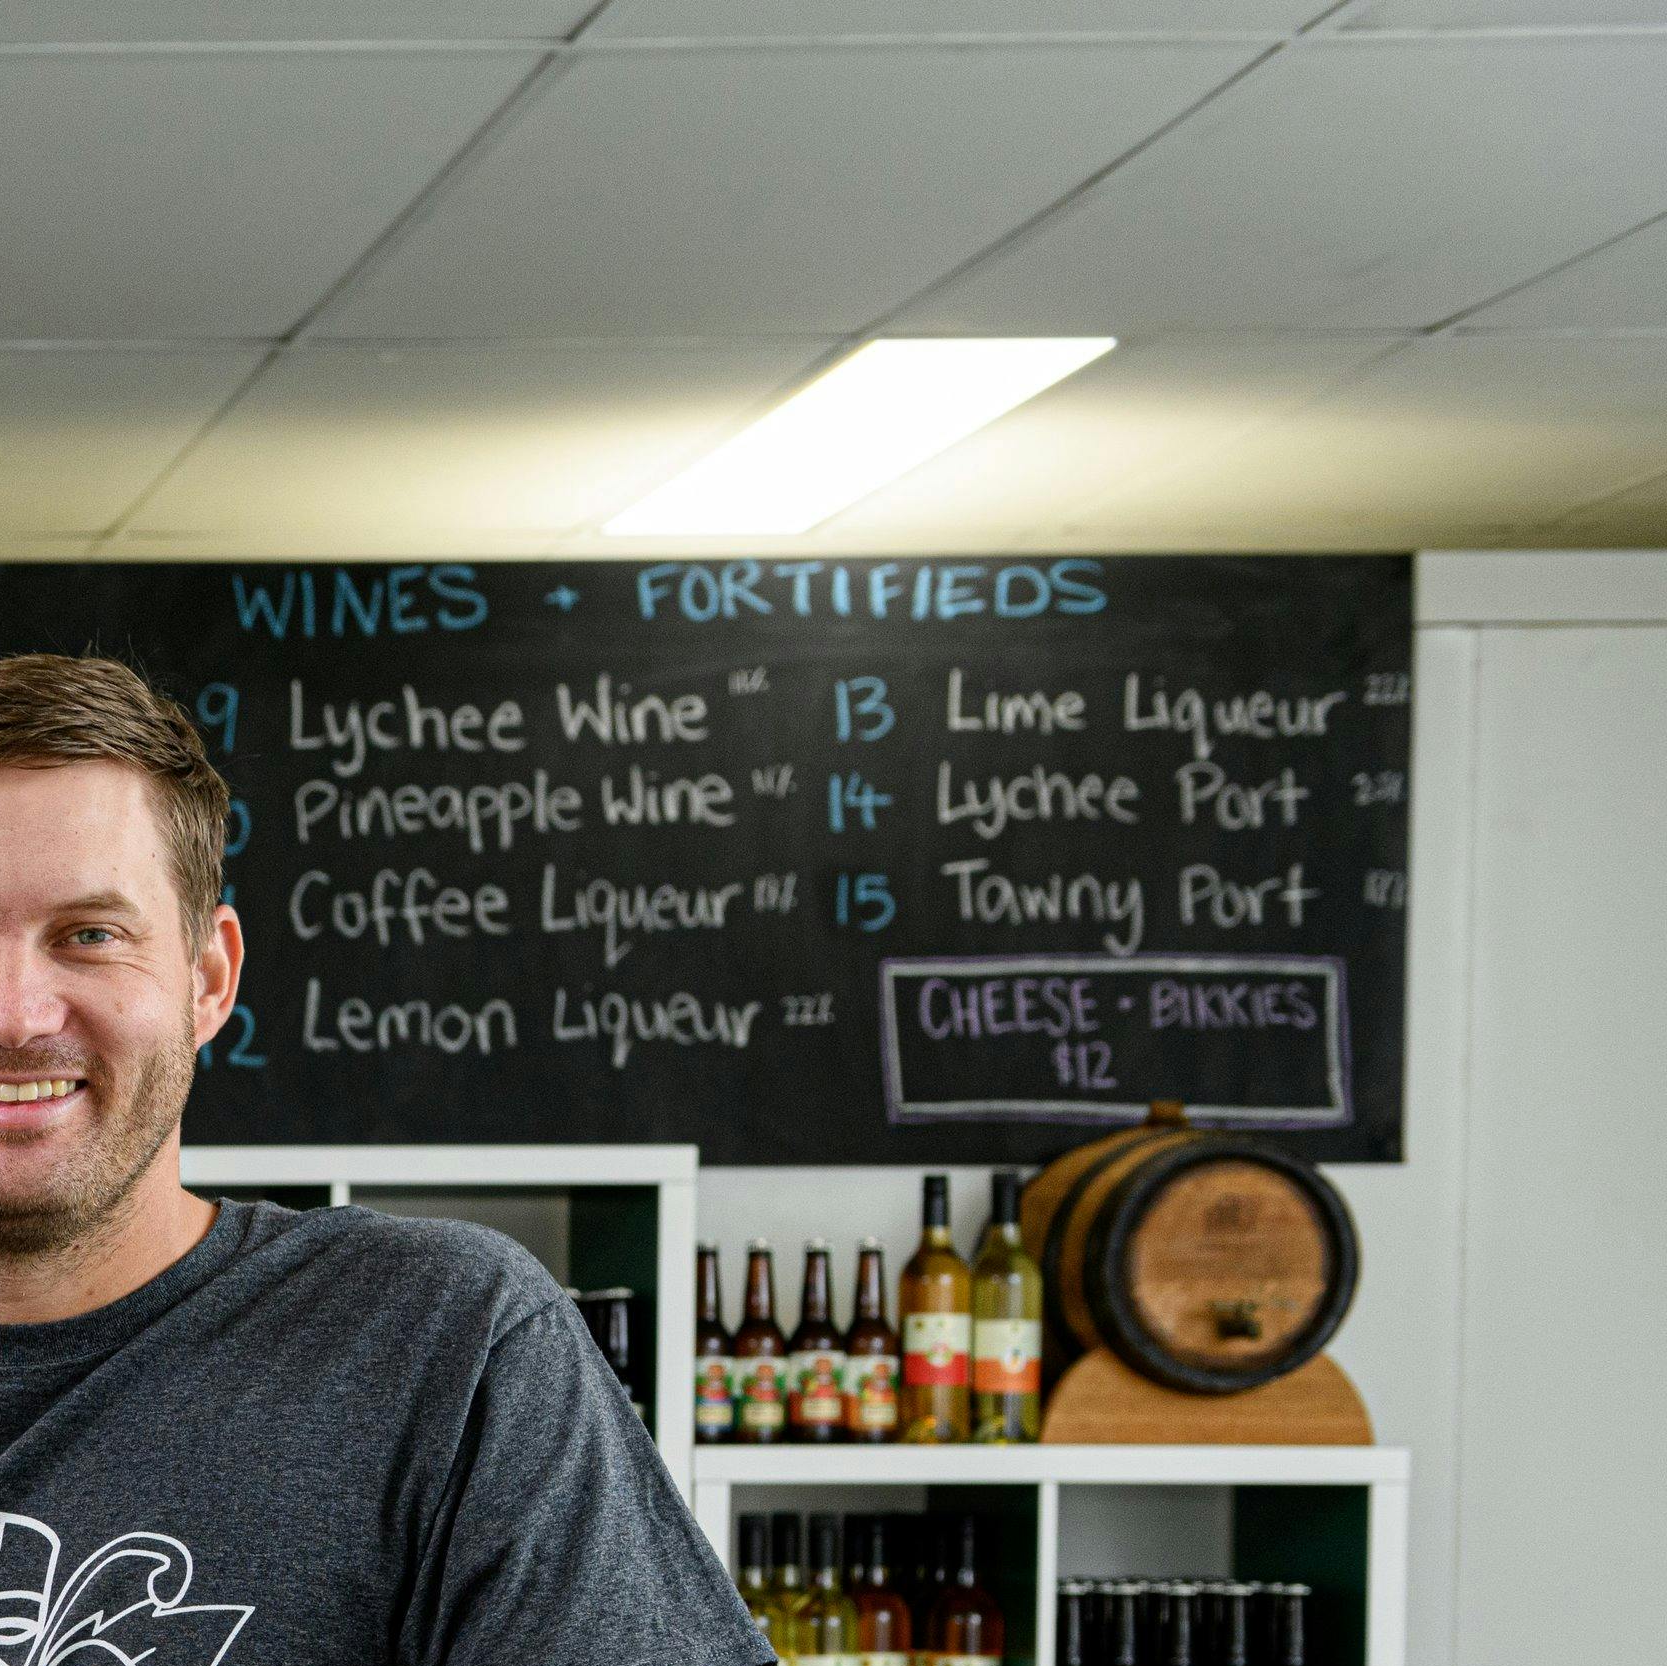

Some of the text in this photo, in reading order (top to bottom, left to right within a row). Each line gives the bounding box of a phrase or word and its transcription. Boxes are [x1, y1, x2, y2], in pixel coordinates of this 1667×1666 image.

[233, 565, 487, 640] WINES
[637, 558, 1109, 622] FORTIFIEDS
[197, 683, 239, 753] 9
[288, 679, 525, 776] Lychee
[556, 671, 708, 743] Wine
[836, 676, 896, 742] 13
[947, 668, 1087, 734] Lime
[1125, 672, 1346, 761] Liqueur
[294, 770, 583, 854] Pineapple
[600, 764, 737, 828] Wine
[828, 772, 891, 833] 14
[936, 760, 1140, 840] Lychee
[1176, 762, 1309, 830] Port
[288, 868, 509, 947] Coffee
[542, 864, 745, 967] Liqueur
[836, 874, 896, 932] 15
[941, 857, 1143, 957] Tawny
[1178, 864, 1321, 927] Port
[303, 978, 518, 1055] Lemon
[553, 988, 761, 1069] Liqueur
[919, 978, 1098, 1040] CHEESE
